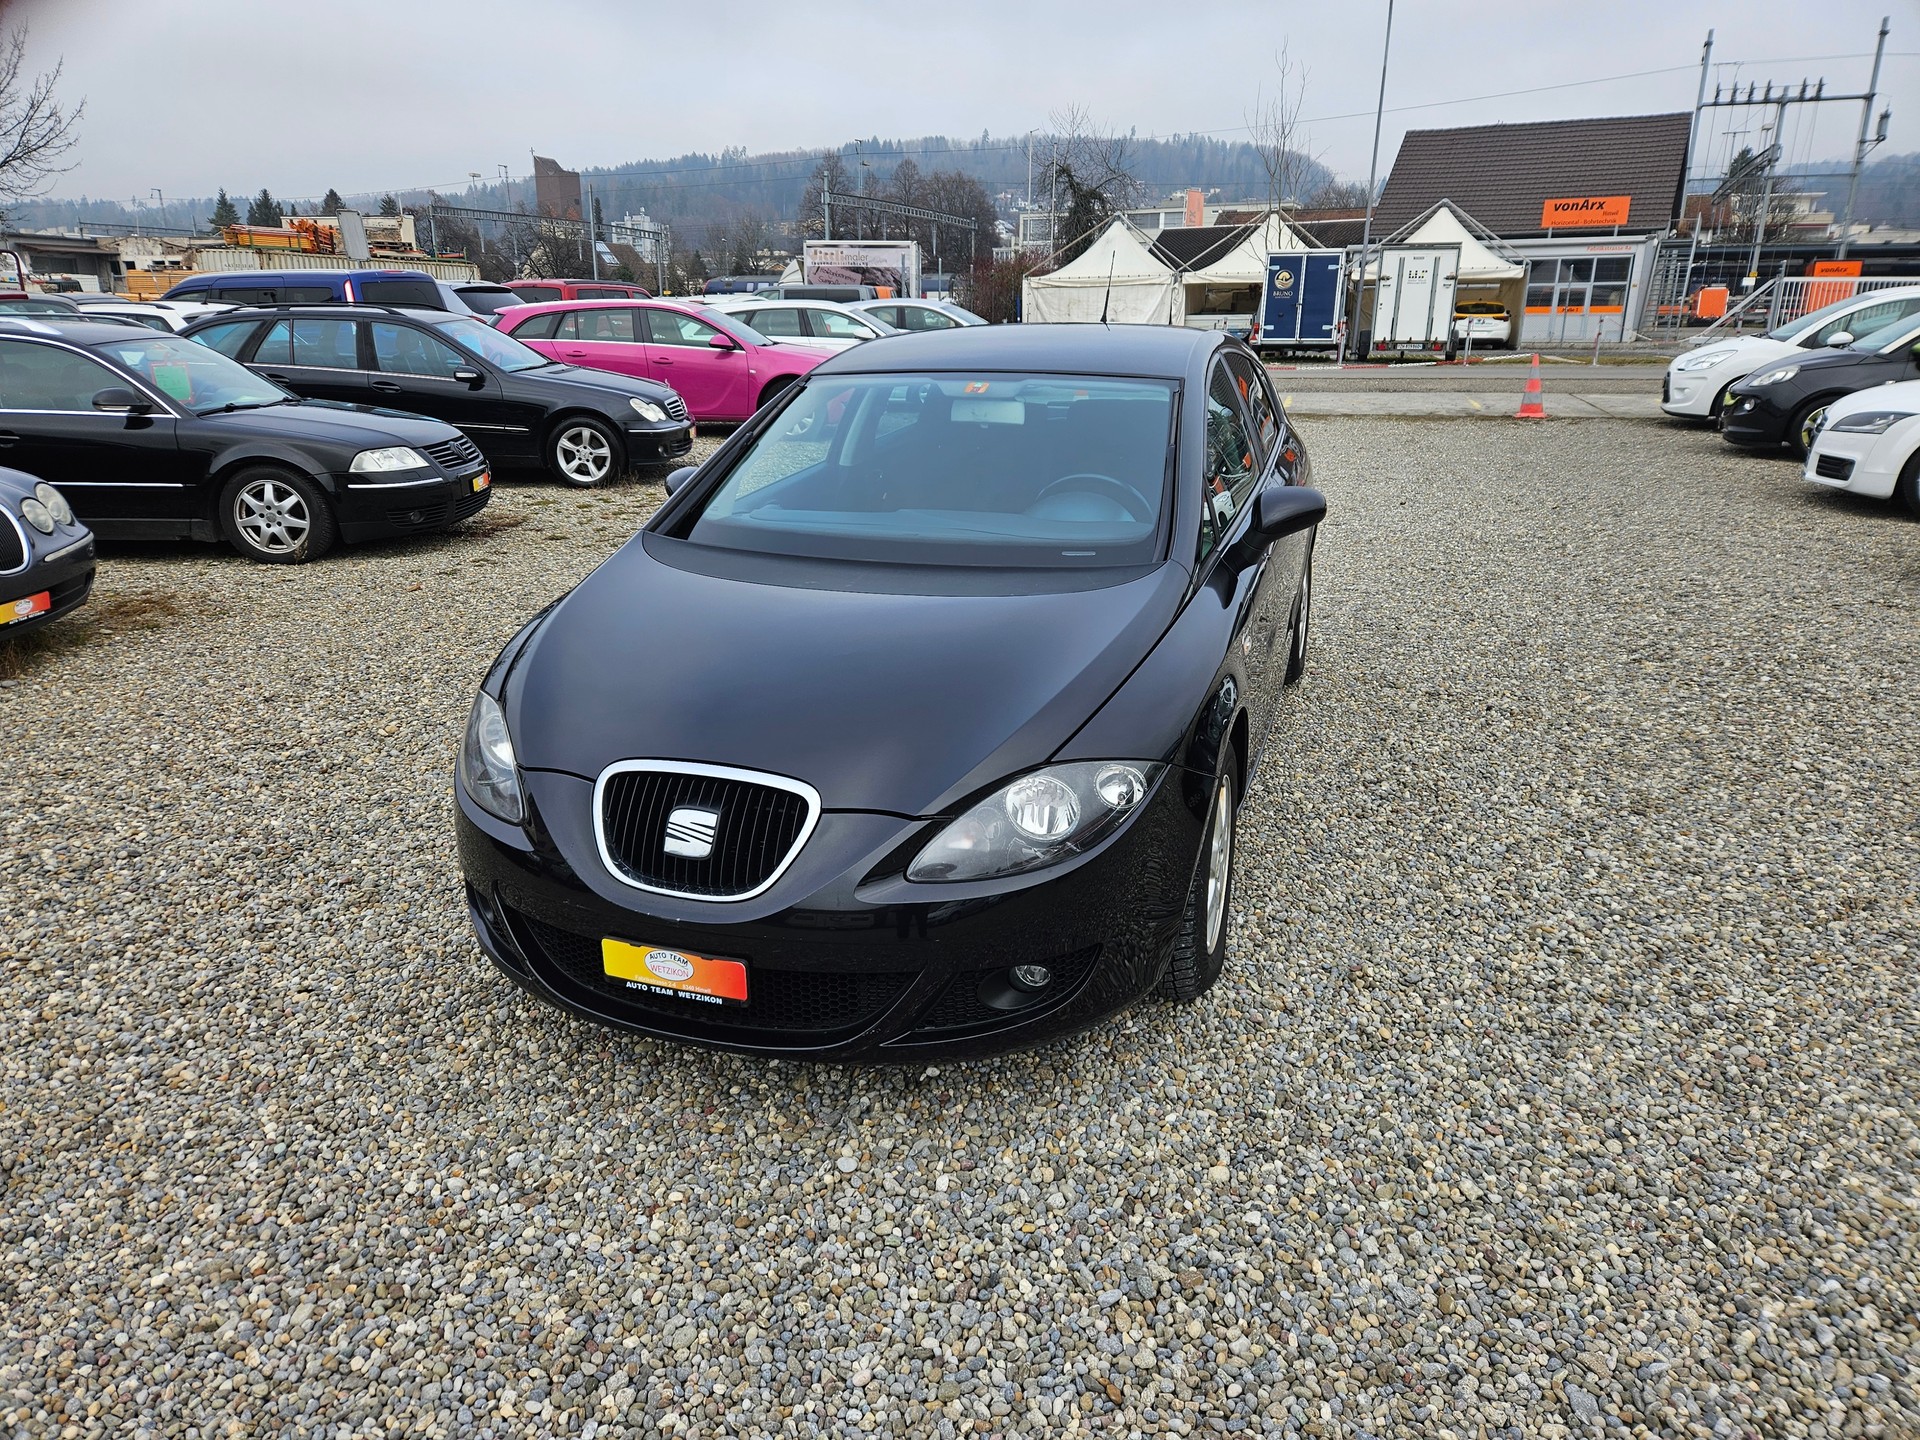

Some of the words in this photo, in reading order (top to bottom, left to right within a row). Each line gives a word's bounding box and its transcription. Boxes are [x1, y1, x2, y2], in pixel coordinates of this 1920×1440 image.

[1554, 199, 1606, 211] vonArx
[649, 952, 667, 960] AUTO
[670, 954, 689, 967] TEAM
[650, 964, 689, 977] WETZIKON
[626, 981, 648, 991] AUTO
[650, 986, 674, 996] TEAM
[677, 990, 723, 1005] WETZIKON
